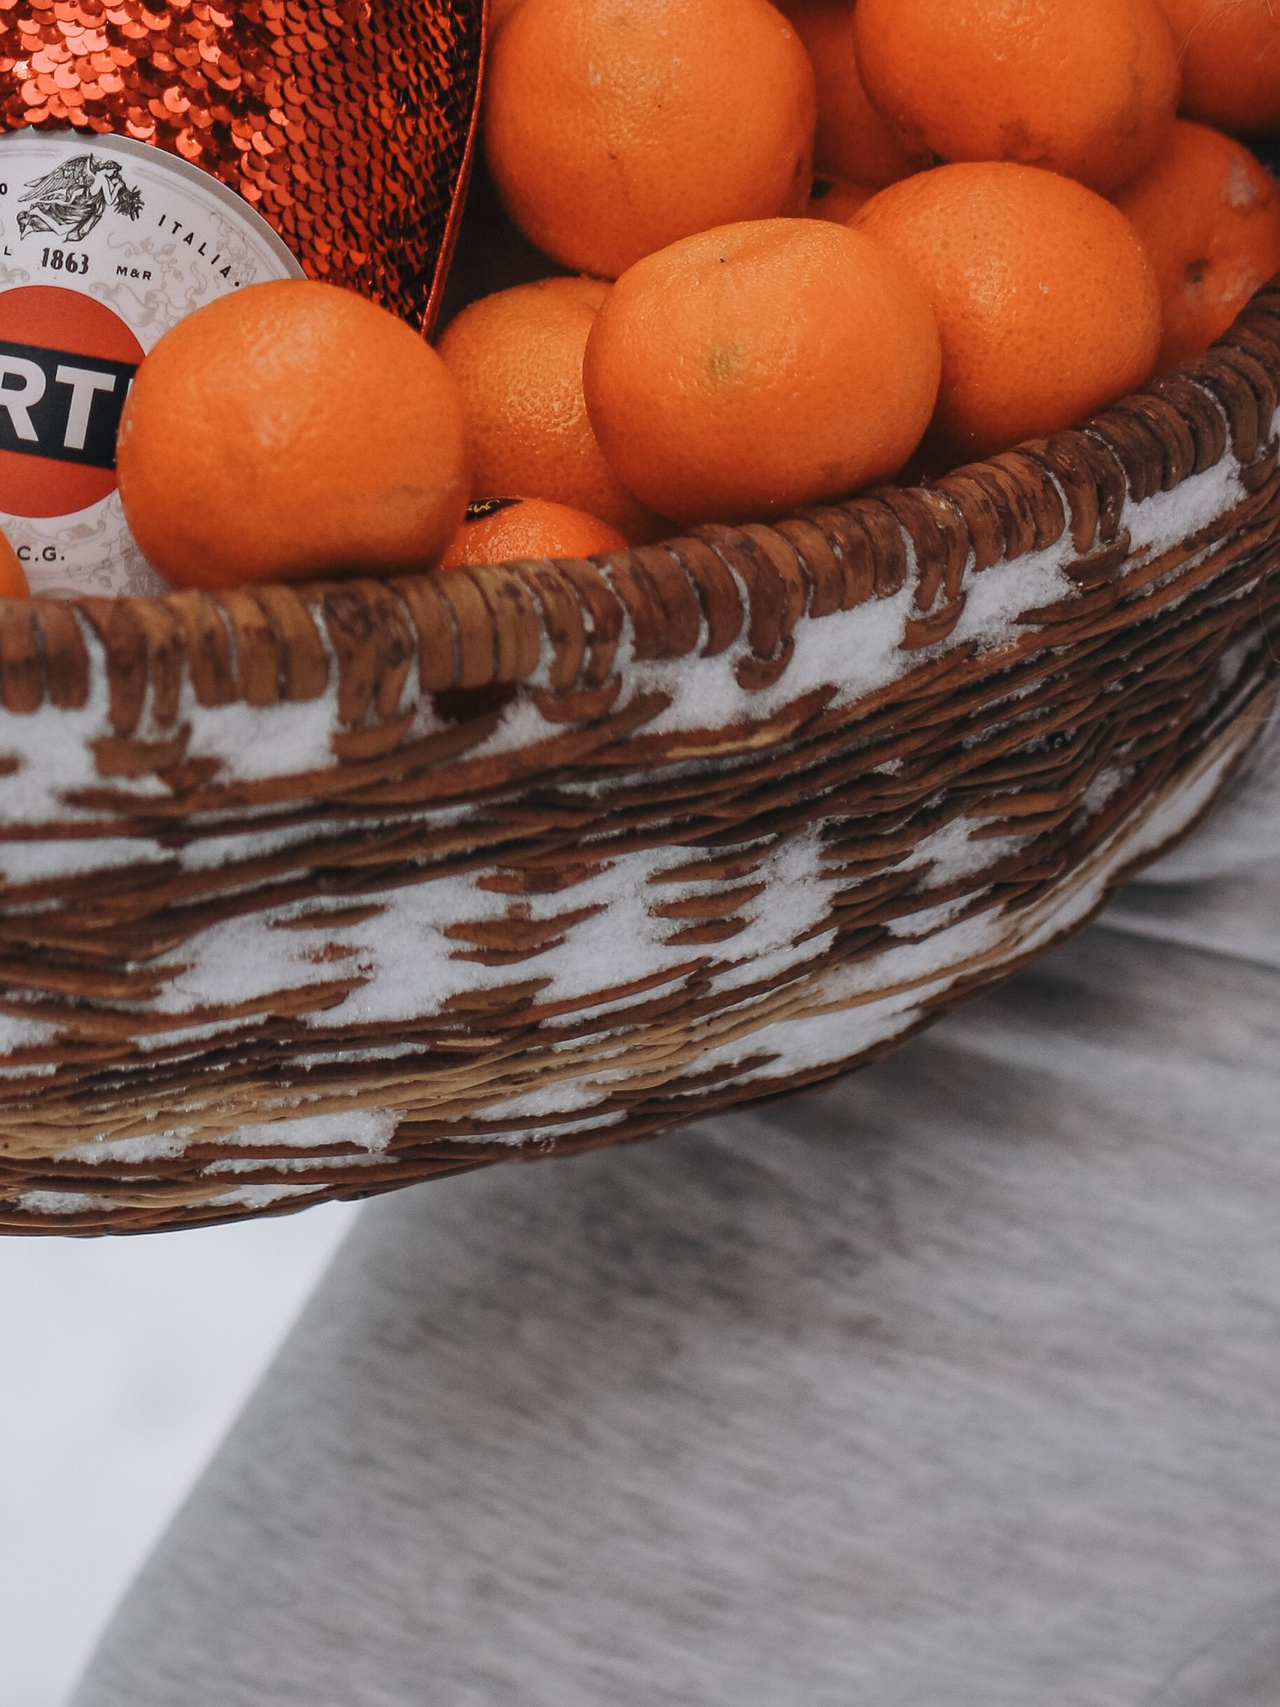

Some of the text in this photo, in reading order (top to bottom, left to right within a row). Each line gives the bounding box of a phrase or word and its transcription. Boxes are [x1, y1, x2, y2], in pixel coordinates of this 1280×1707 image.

[41, 247, 90, 275] 1863
[116, 265, 152, 281] M&R
[158, 214, 233, 279] ITALIA
